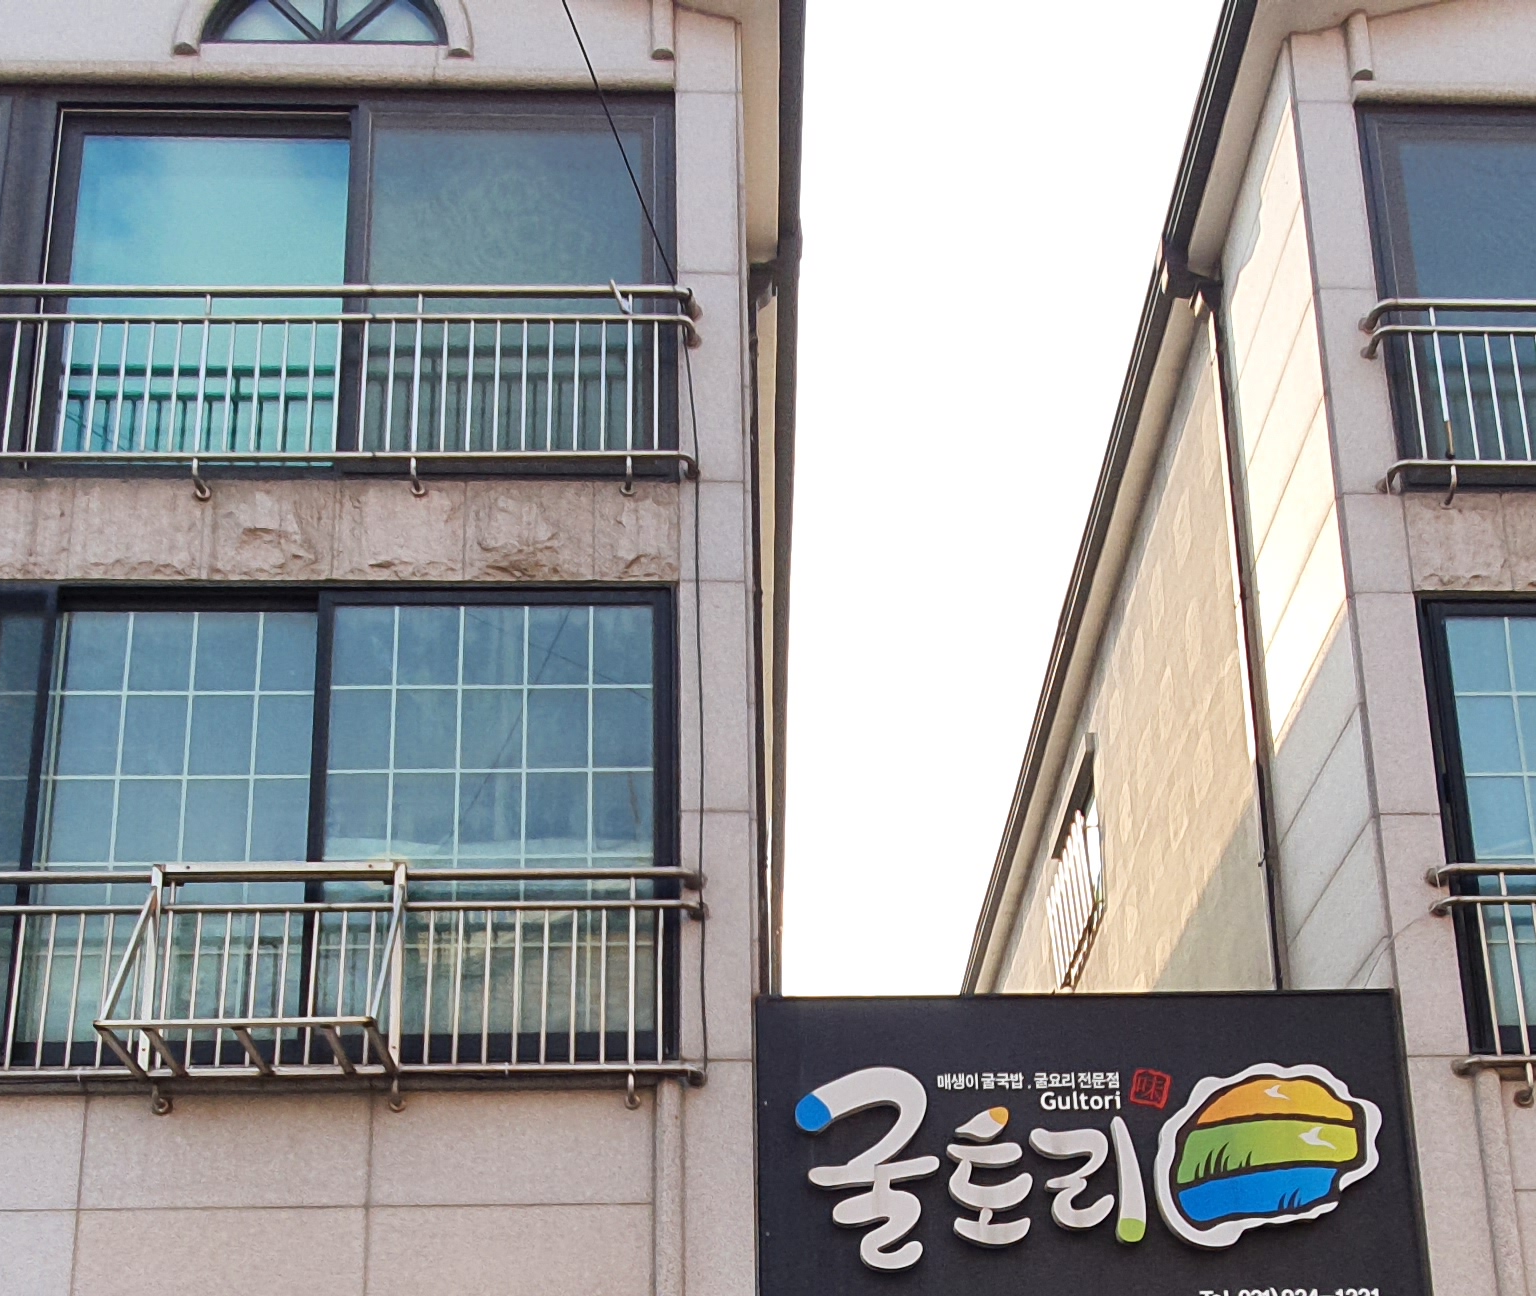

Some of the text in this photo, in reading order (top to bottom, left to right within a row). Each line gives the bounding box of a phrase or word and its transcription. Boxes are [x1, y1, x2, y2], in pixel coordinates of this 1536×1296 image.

[936, 1071, 1121, 1091] 매생이 굴국밥 굴요리 전문점
[1040, 1090, 1122, 1111] Gultori
[795, 1066, 1148, 1273] 굴토리
